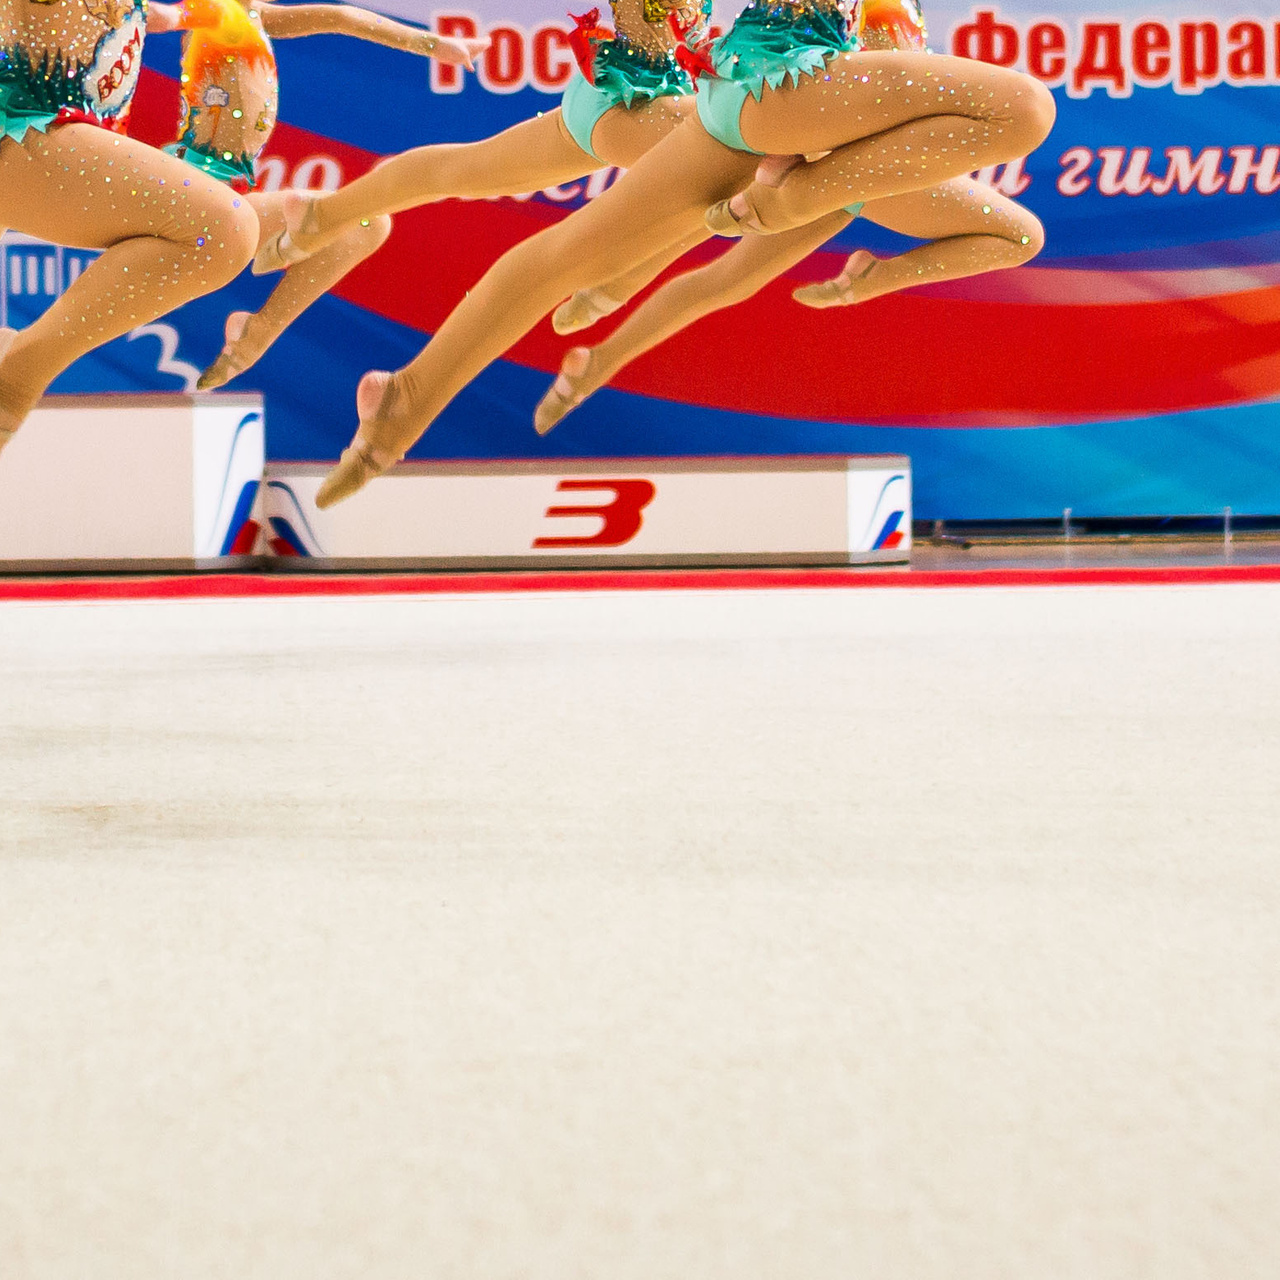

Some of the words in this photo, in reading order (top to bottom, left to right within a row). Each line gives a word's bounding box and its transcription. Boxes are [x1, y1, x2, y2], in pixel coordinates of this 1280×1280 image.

[97, 26, 140, 103] BOOM
[951, 11, 1280, 91] Федера
[530, 478, 656, 550] 3
